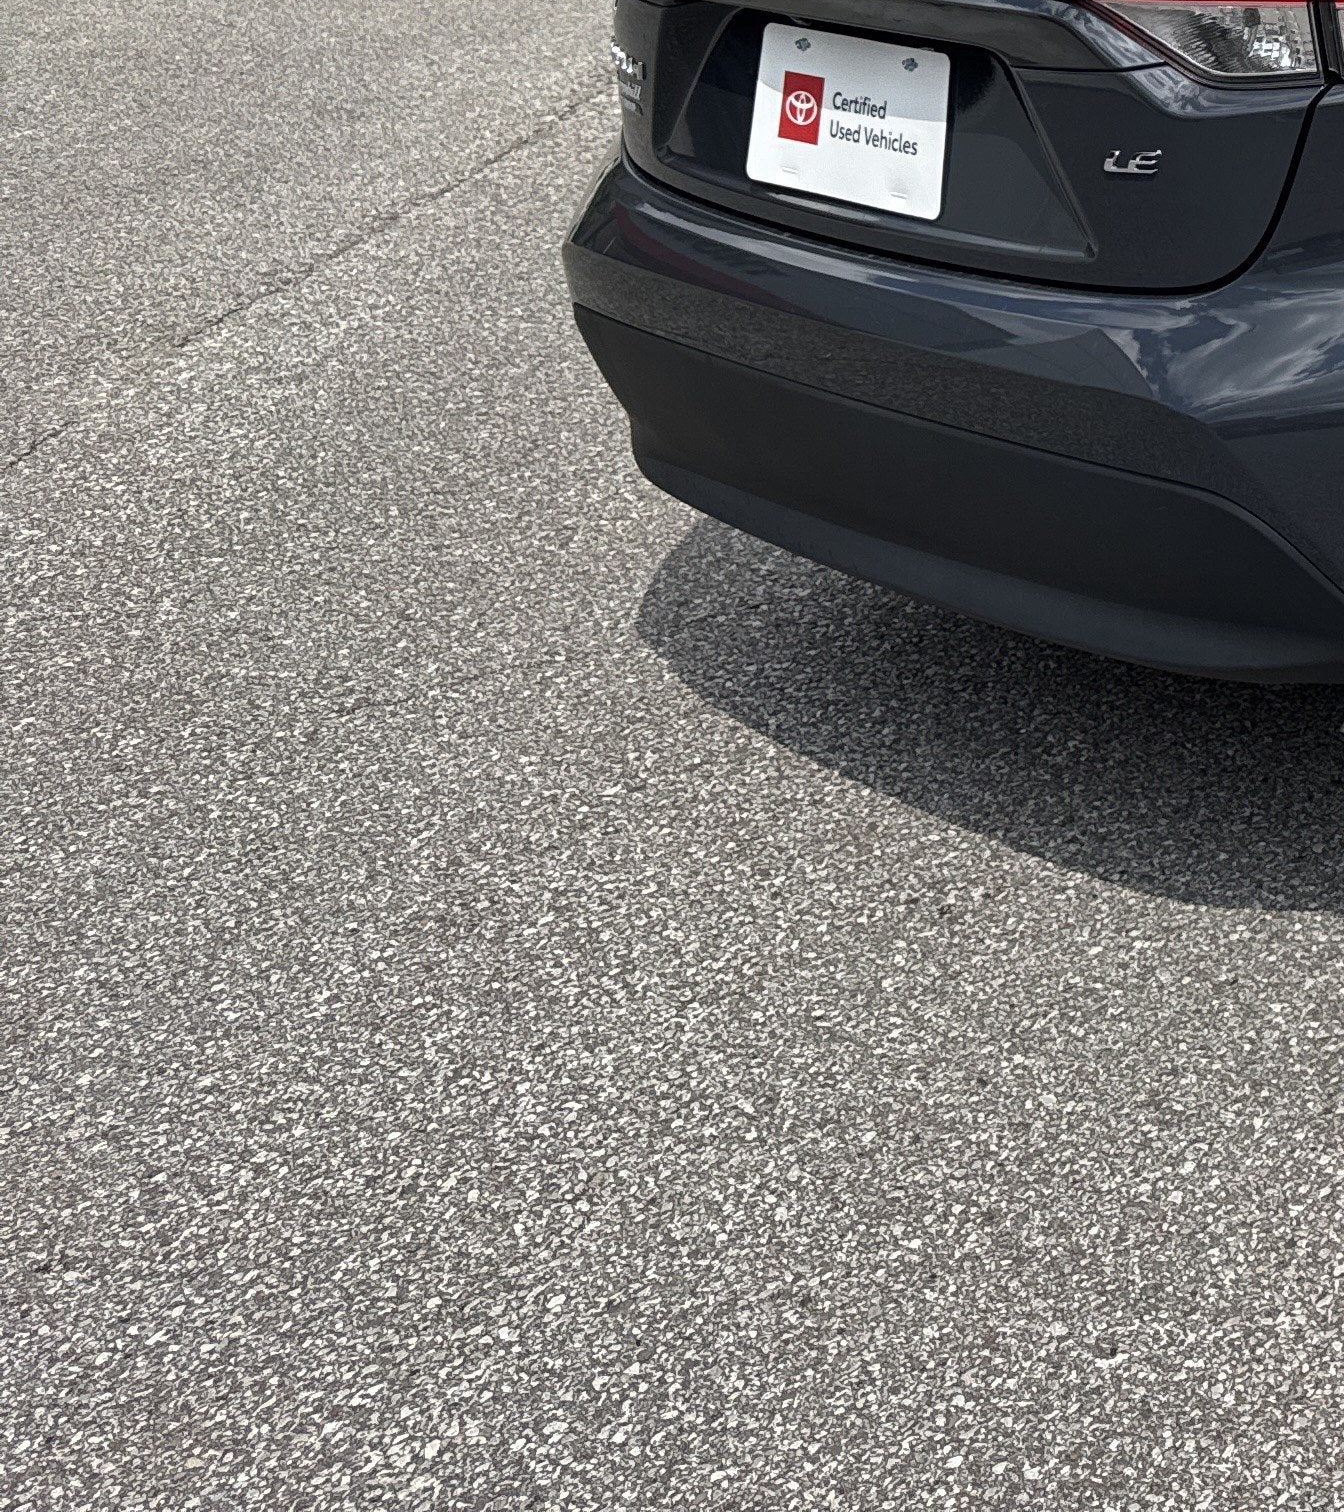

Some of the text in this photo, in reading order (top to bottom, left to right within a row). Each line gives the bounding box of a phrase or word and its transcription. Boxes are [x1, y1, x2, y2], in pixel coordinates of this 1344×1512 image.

[833, 92, 887, 119] Certified
[830, 119, 918, 156] Used Vehicles
[1104, 149, 1162, 174] LE
